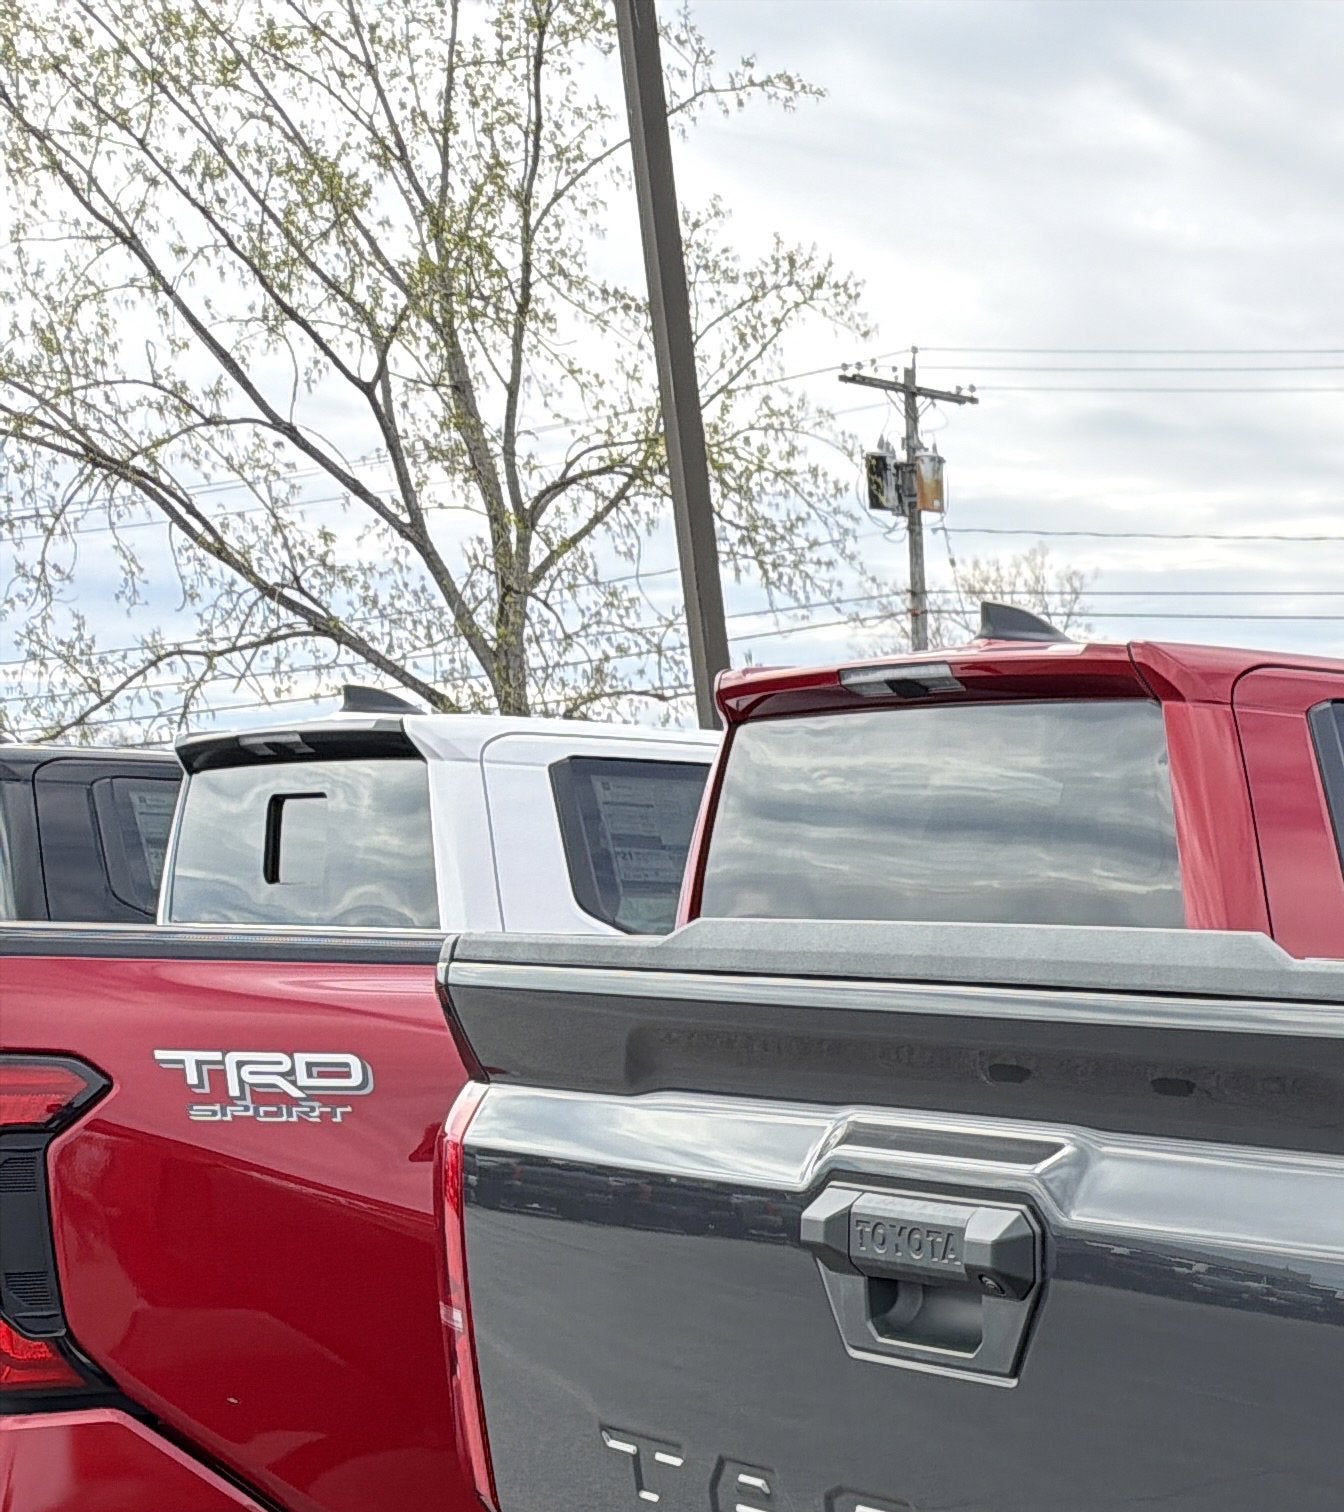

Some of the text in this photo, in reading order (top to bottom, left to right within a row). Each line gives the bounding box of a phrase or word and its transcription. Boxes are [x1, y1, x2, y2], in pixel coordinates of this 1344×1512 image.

[154, 1049, 374, 1103] TRD
[187, 1103, 352, 1123] SPORT
[854, 1219, 962, 1266] TOYOTA
